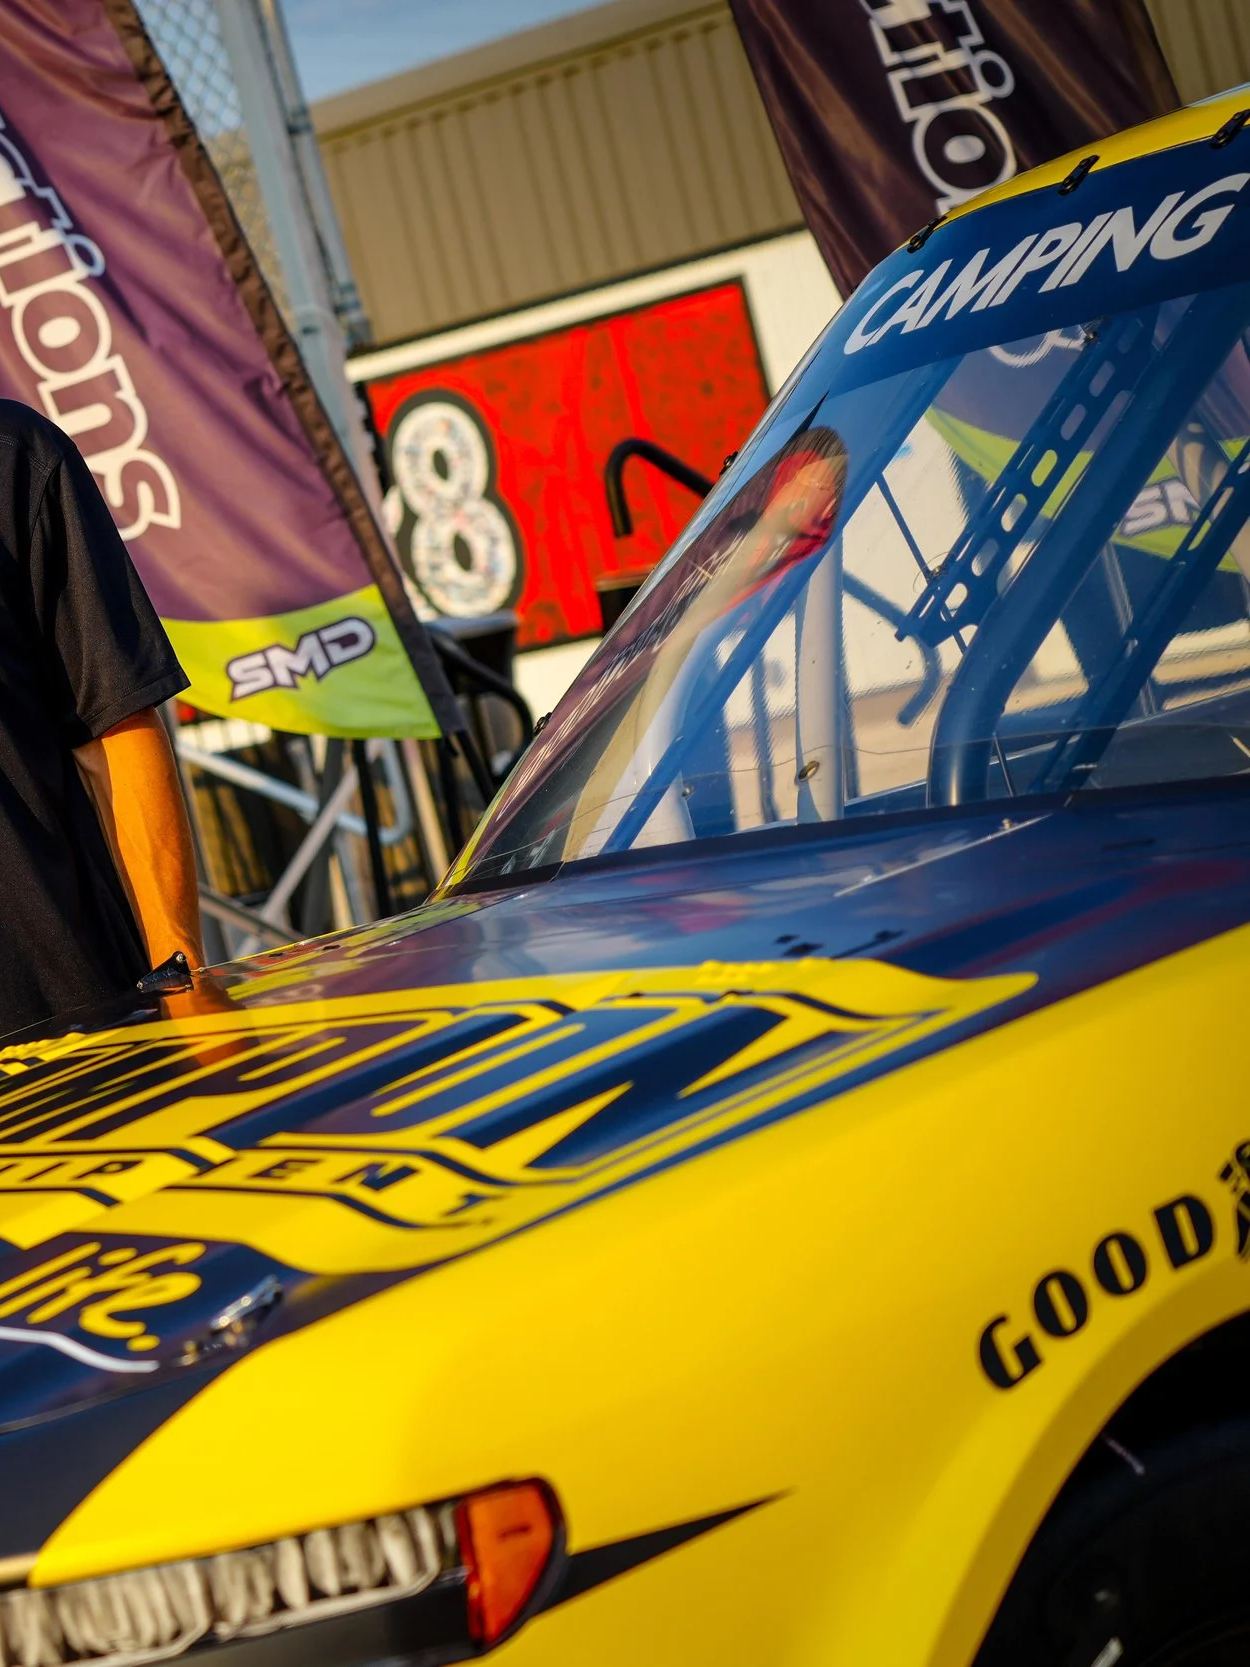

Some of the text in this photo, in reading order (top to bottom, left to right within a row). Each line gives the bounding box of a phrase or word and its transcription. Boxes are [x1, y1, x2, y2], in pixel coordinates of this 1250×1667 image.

[843, 172, 1250, 356] CAMPING
[392, 401, 519, 619] 8
[227, 616, 377, 704] SMD
[978, 1193, 1215, 1391] GOOD
